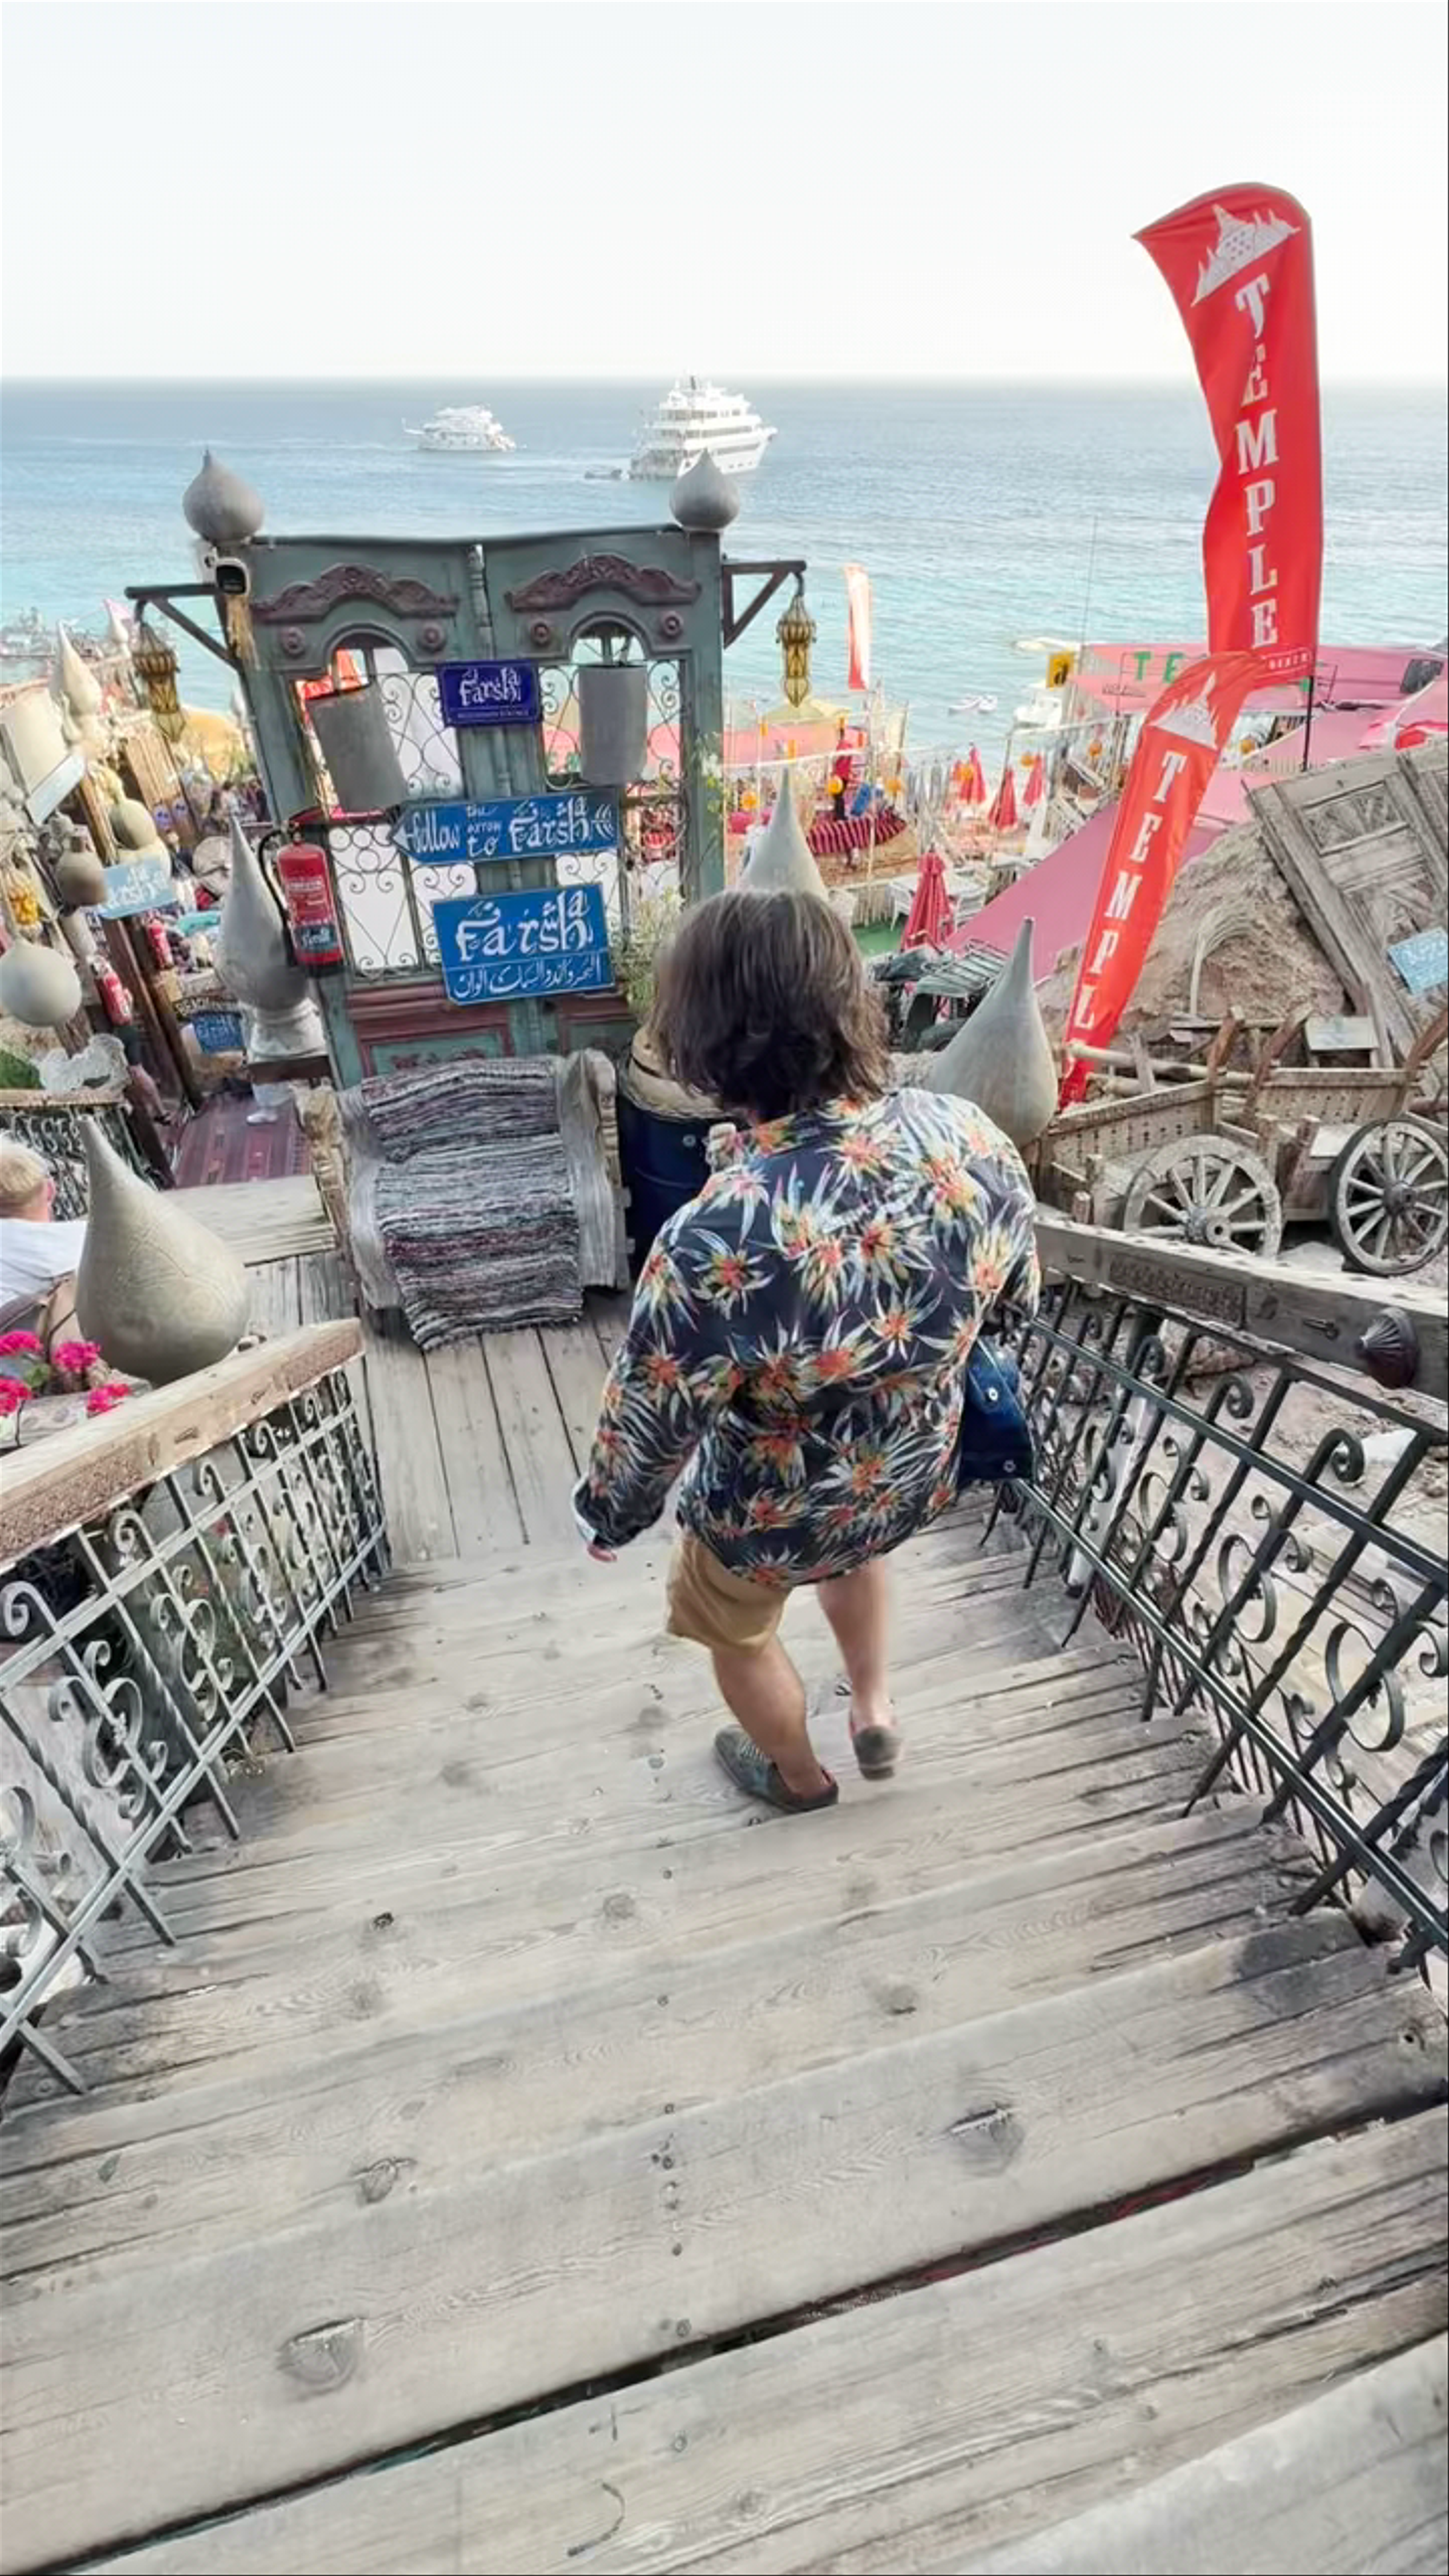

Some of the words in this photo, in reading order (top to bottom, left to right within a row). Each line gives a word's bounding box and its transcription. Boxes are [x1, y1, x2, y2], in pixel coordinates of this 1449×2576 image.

[1234, 273, 1279, 649] TEMPLE
[467, 823, 501, 836] arrow
[467, 837, 498, 858] to
[455, 890, 594, 961] Farsha
